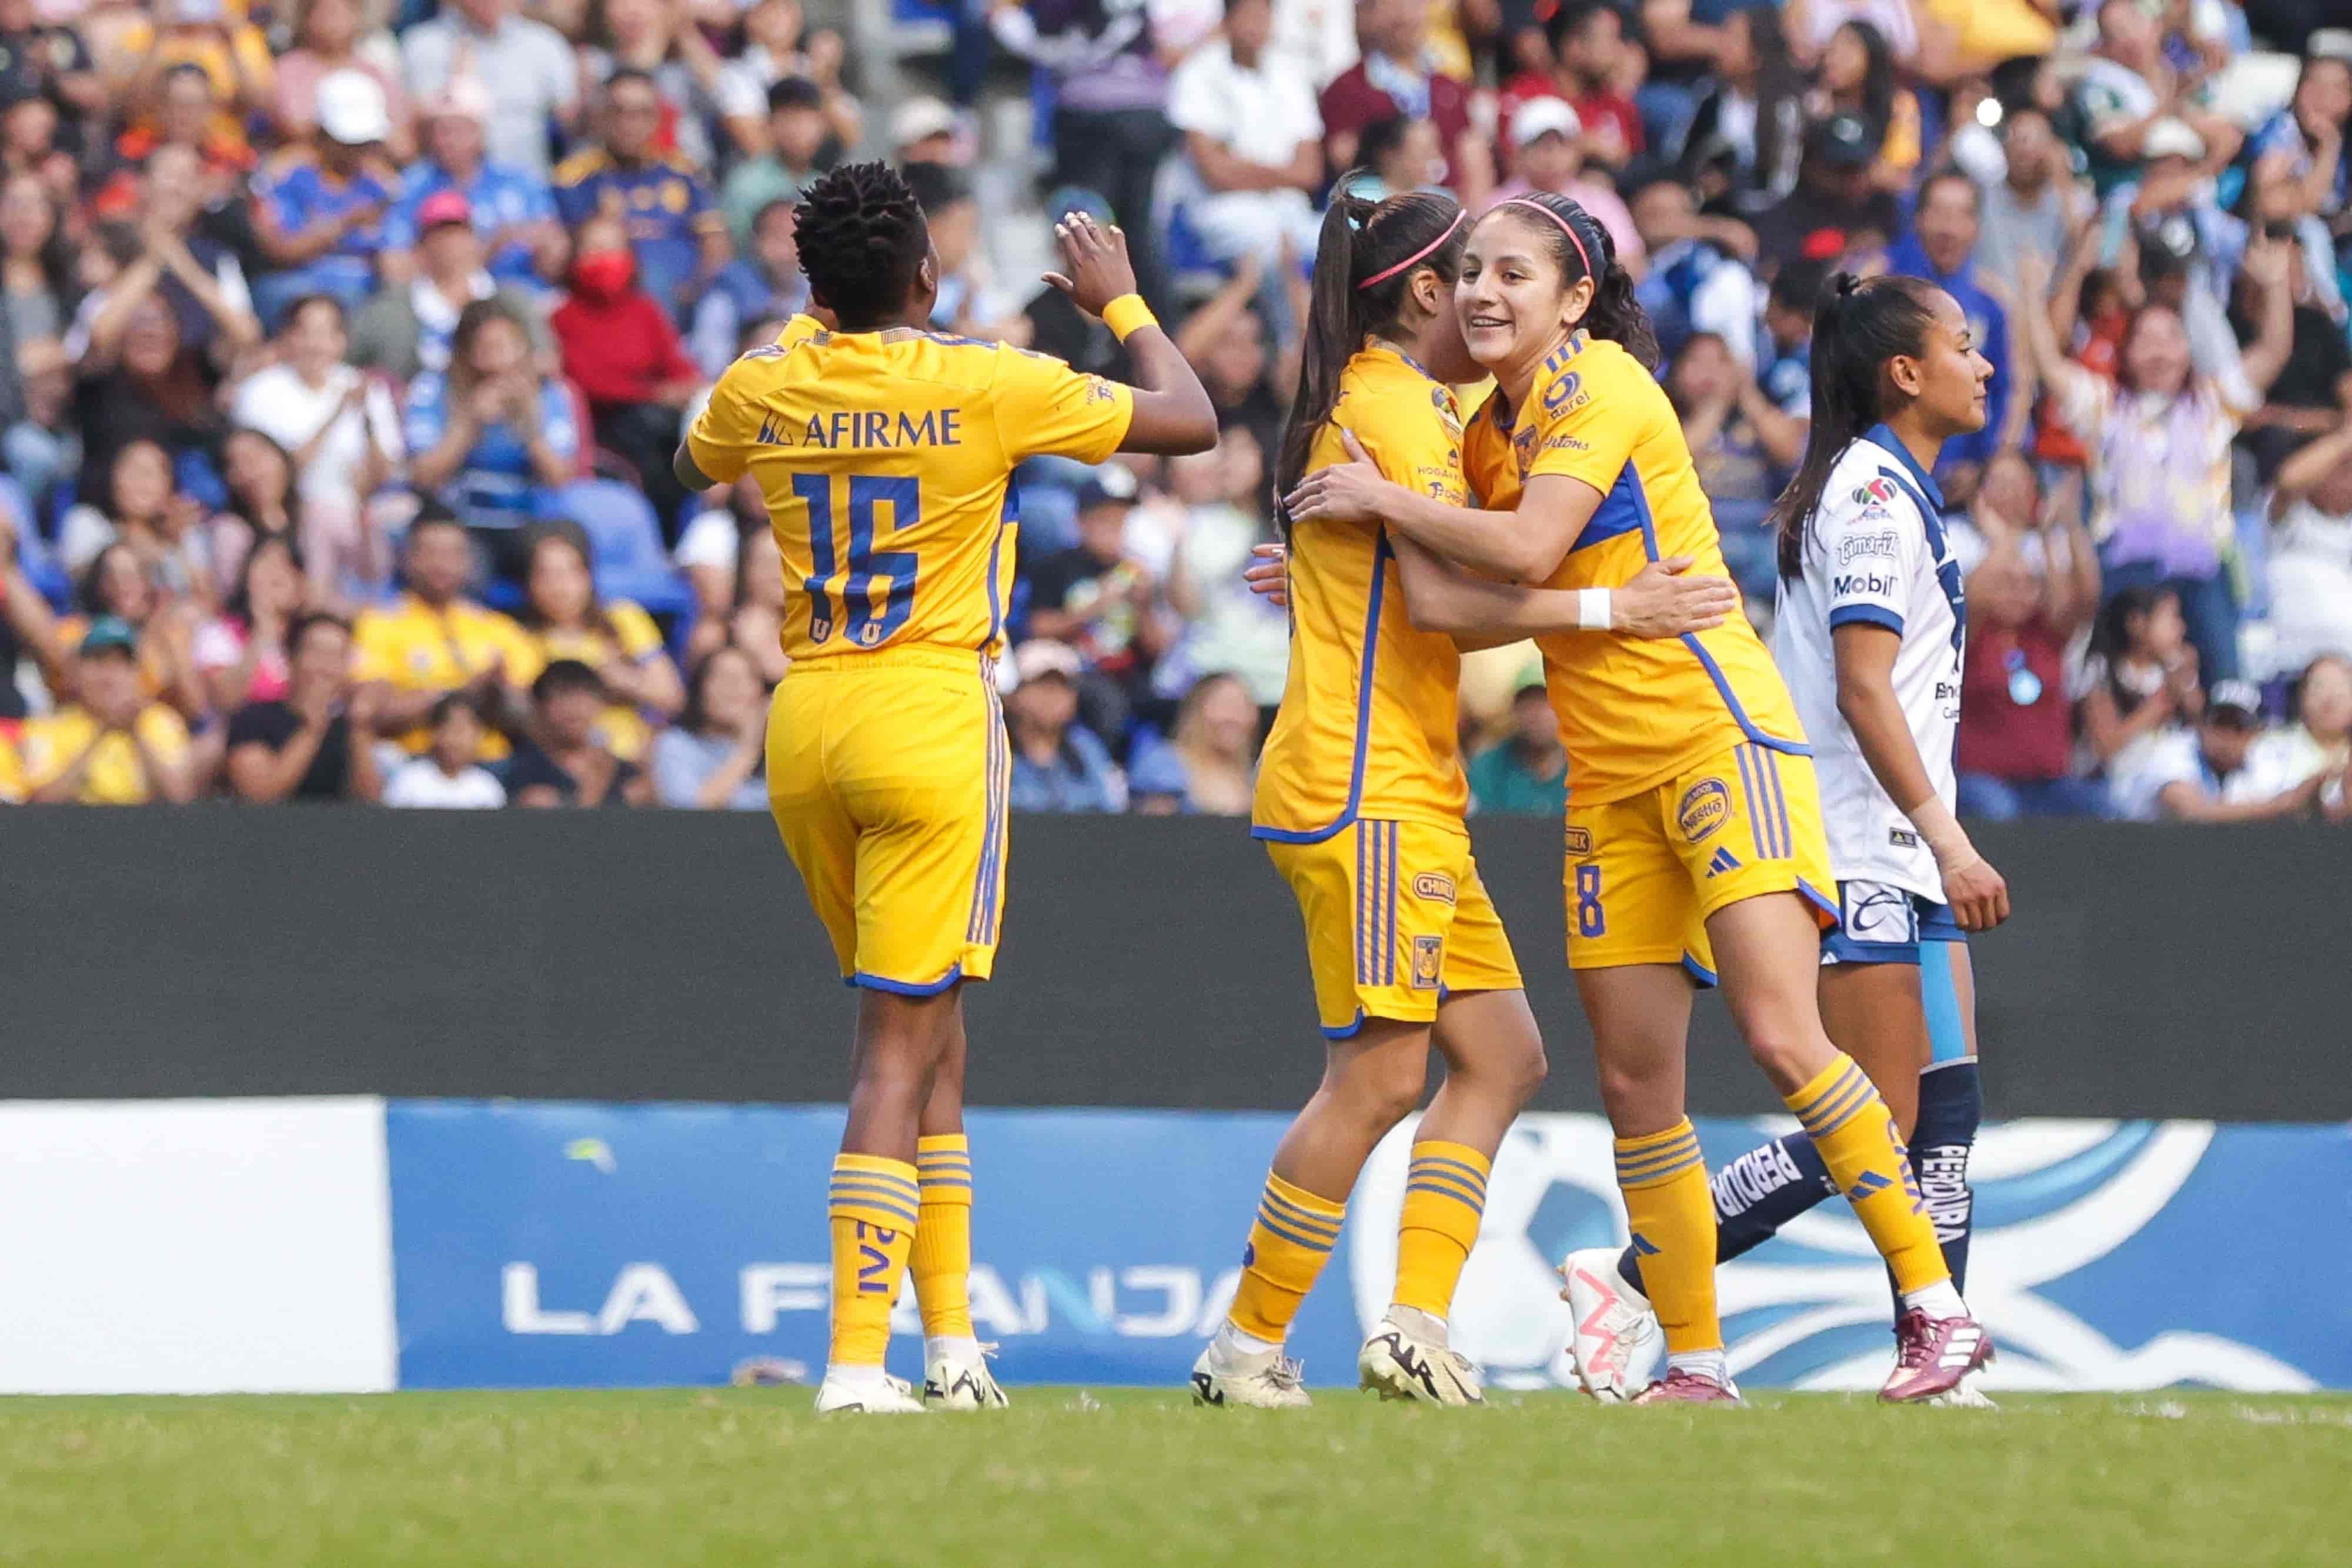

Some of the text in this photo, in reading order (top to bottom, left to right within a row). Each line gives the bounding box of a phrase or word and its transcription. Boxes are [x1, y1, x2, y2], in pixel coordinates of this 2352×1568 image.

[803, 409, 961, 449] AFIRME
[791, 473, 921, 649] 16
[1833, 573, 1899, 597] Mobil
[1576, 864, 1606, 937] 8
[1712, 1138, 1803, 1226] PERDUR
[502, 1261, 1258, 1336] LA FANJ
